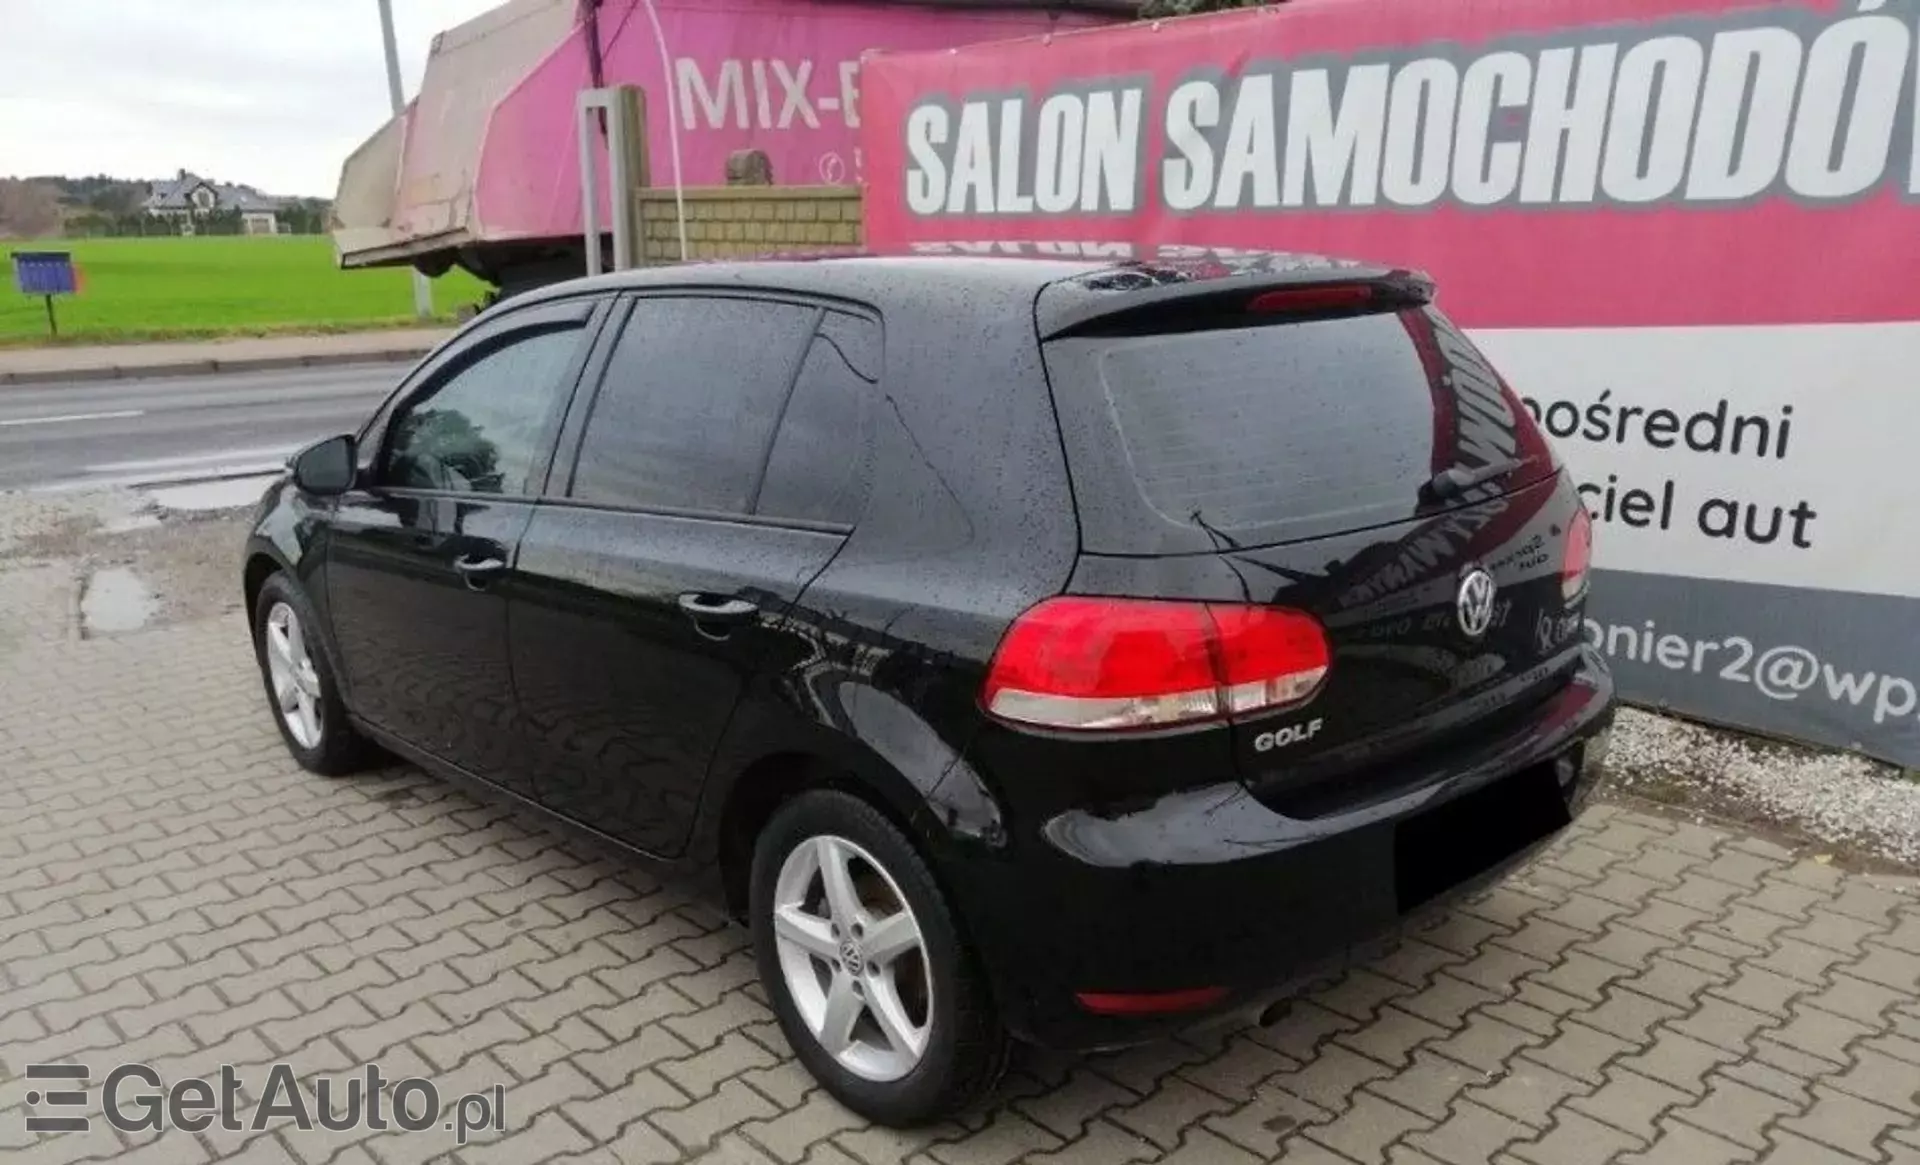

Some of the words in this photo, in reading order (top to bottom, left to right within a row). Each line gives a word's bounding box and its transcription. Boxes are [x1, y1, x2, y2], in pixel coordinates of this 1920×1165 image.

[906, 88, 1142, 215] SALON
[1163, 0, 1920, 210] SAMOCHODÓ
[1697, 499, 1818, 549] aut
[1255, 717, 1323, 752] GOLF
